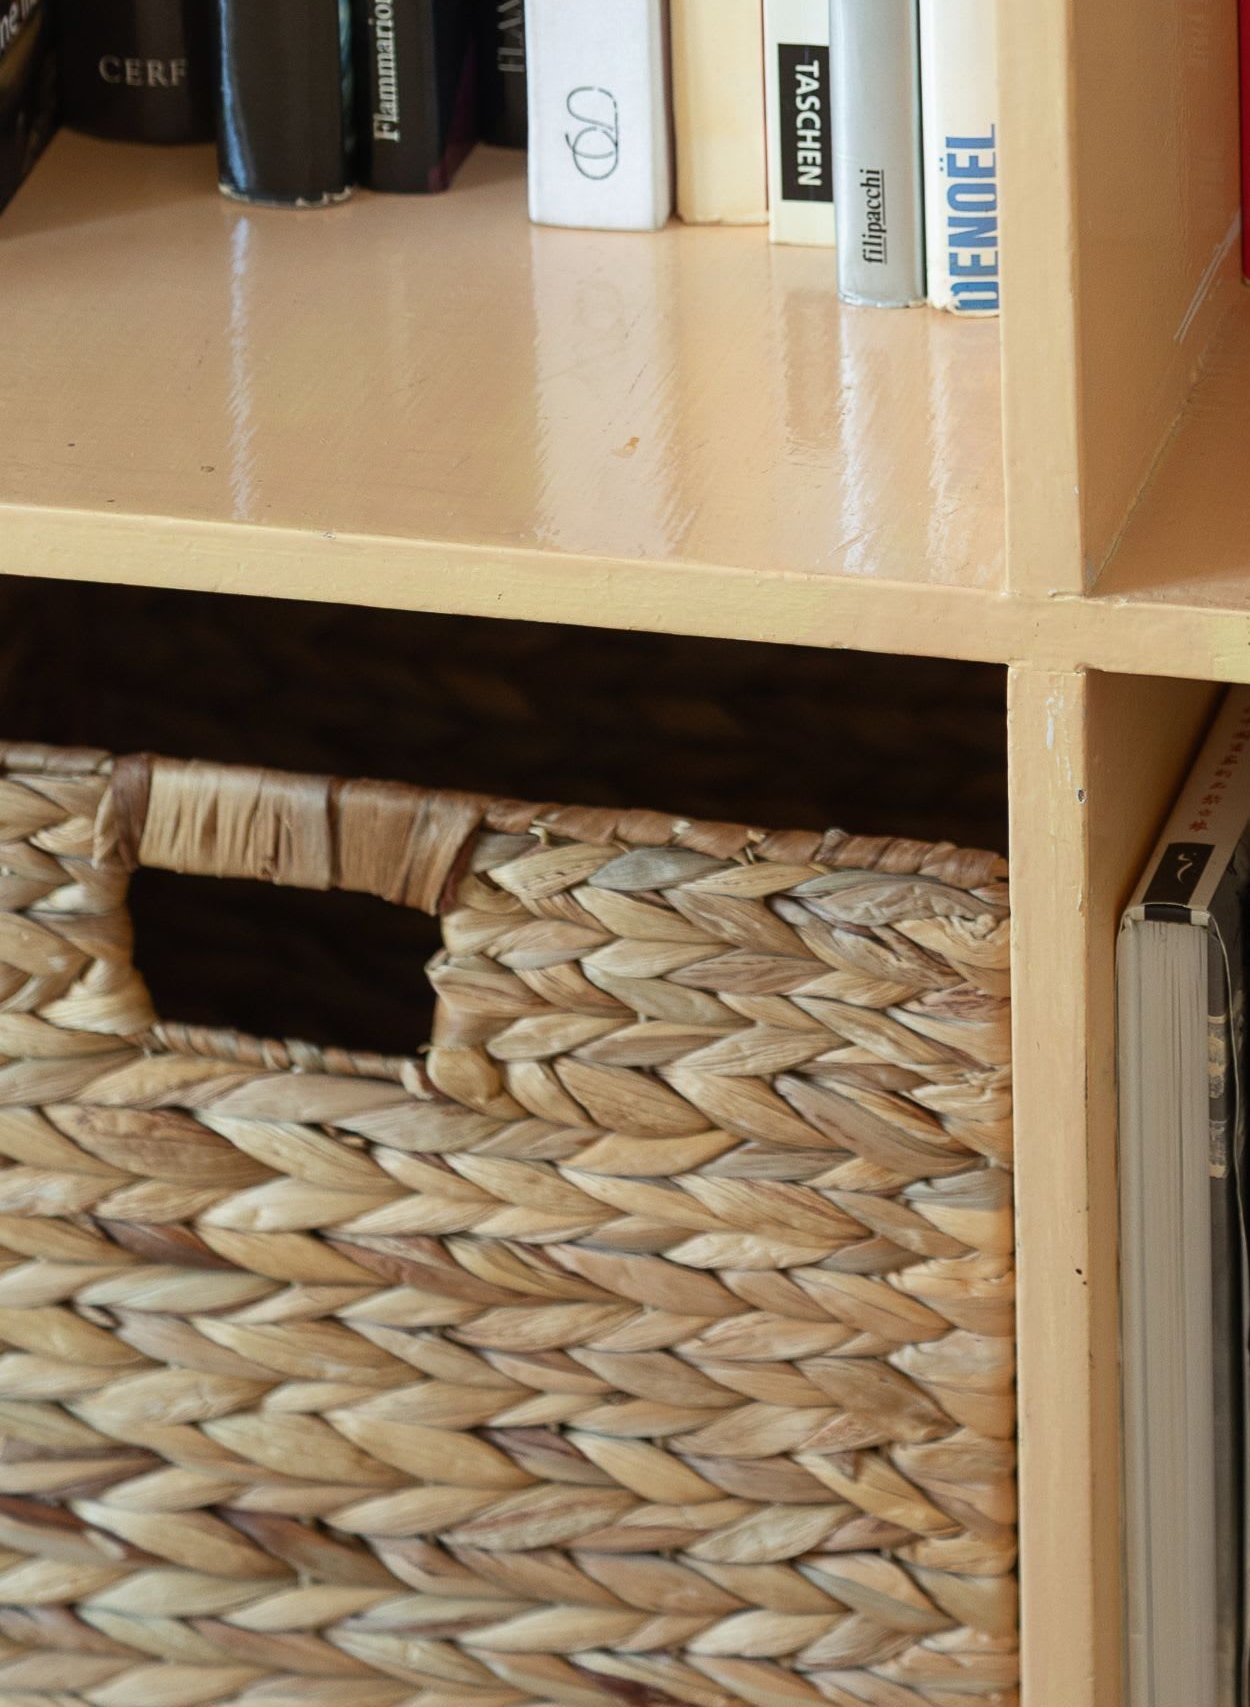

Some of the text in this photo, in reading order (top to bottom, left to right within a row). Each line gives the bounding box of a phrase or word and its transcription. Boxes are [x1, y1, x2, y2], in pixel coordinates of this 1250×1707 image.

[99, 53, 188, 89] CERF
[794, 59, 823, 186] TASCHEN
[860, 169, 888, 265] filipacchi
[939, 124, 1000, 311] DENOËL
